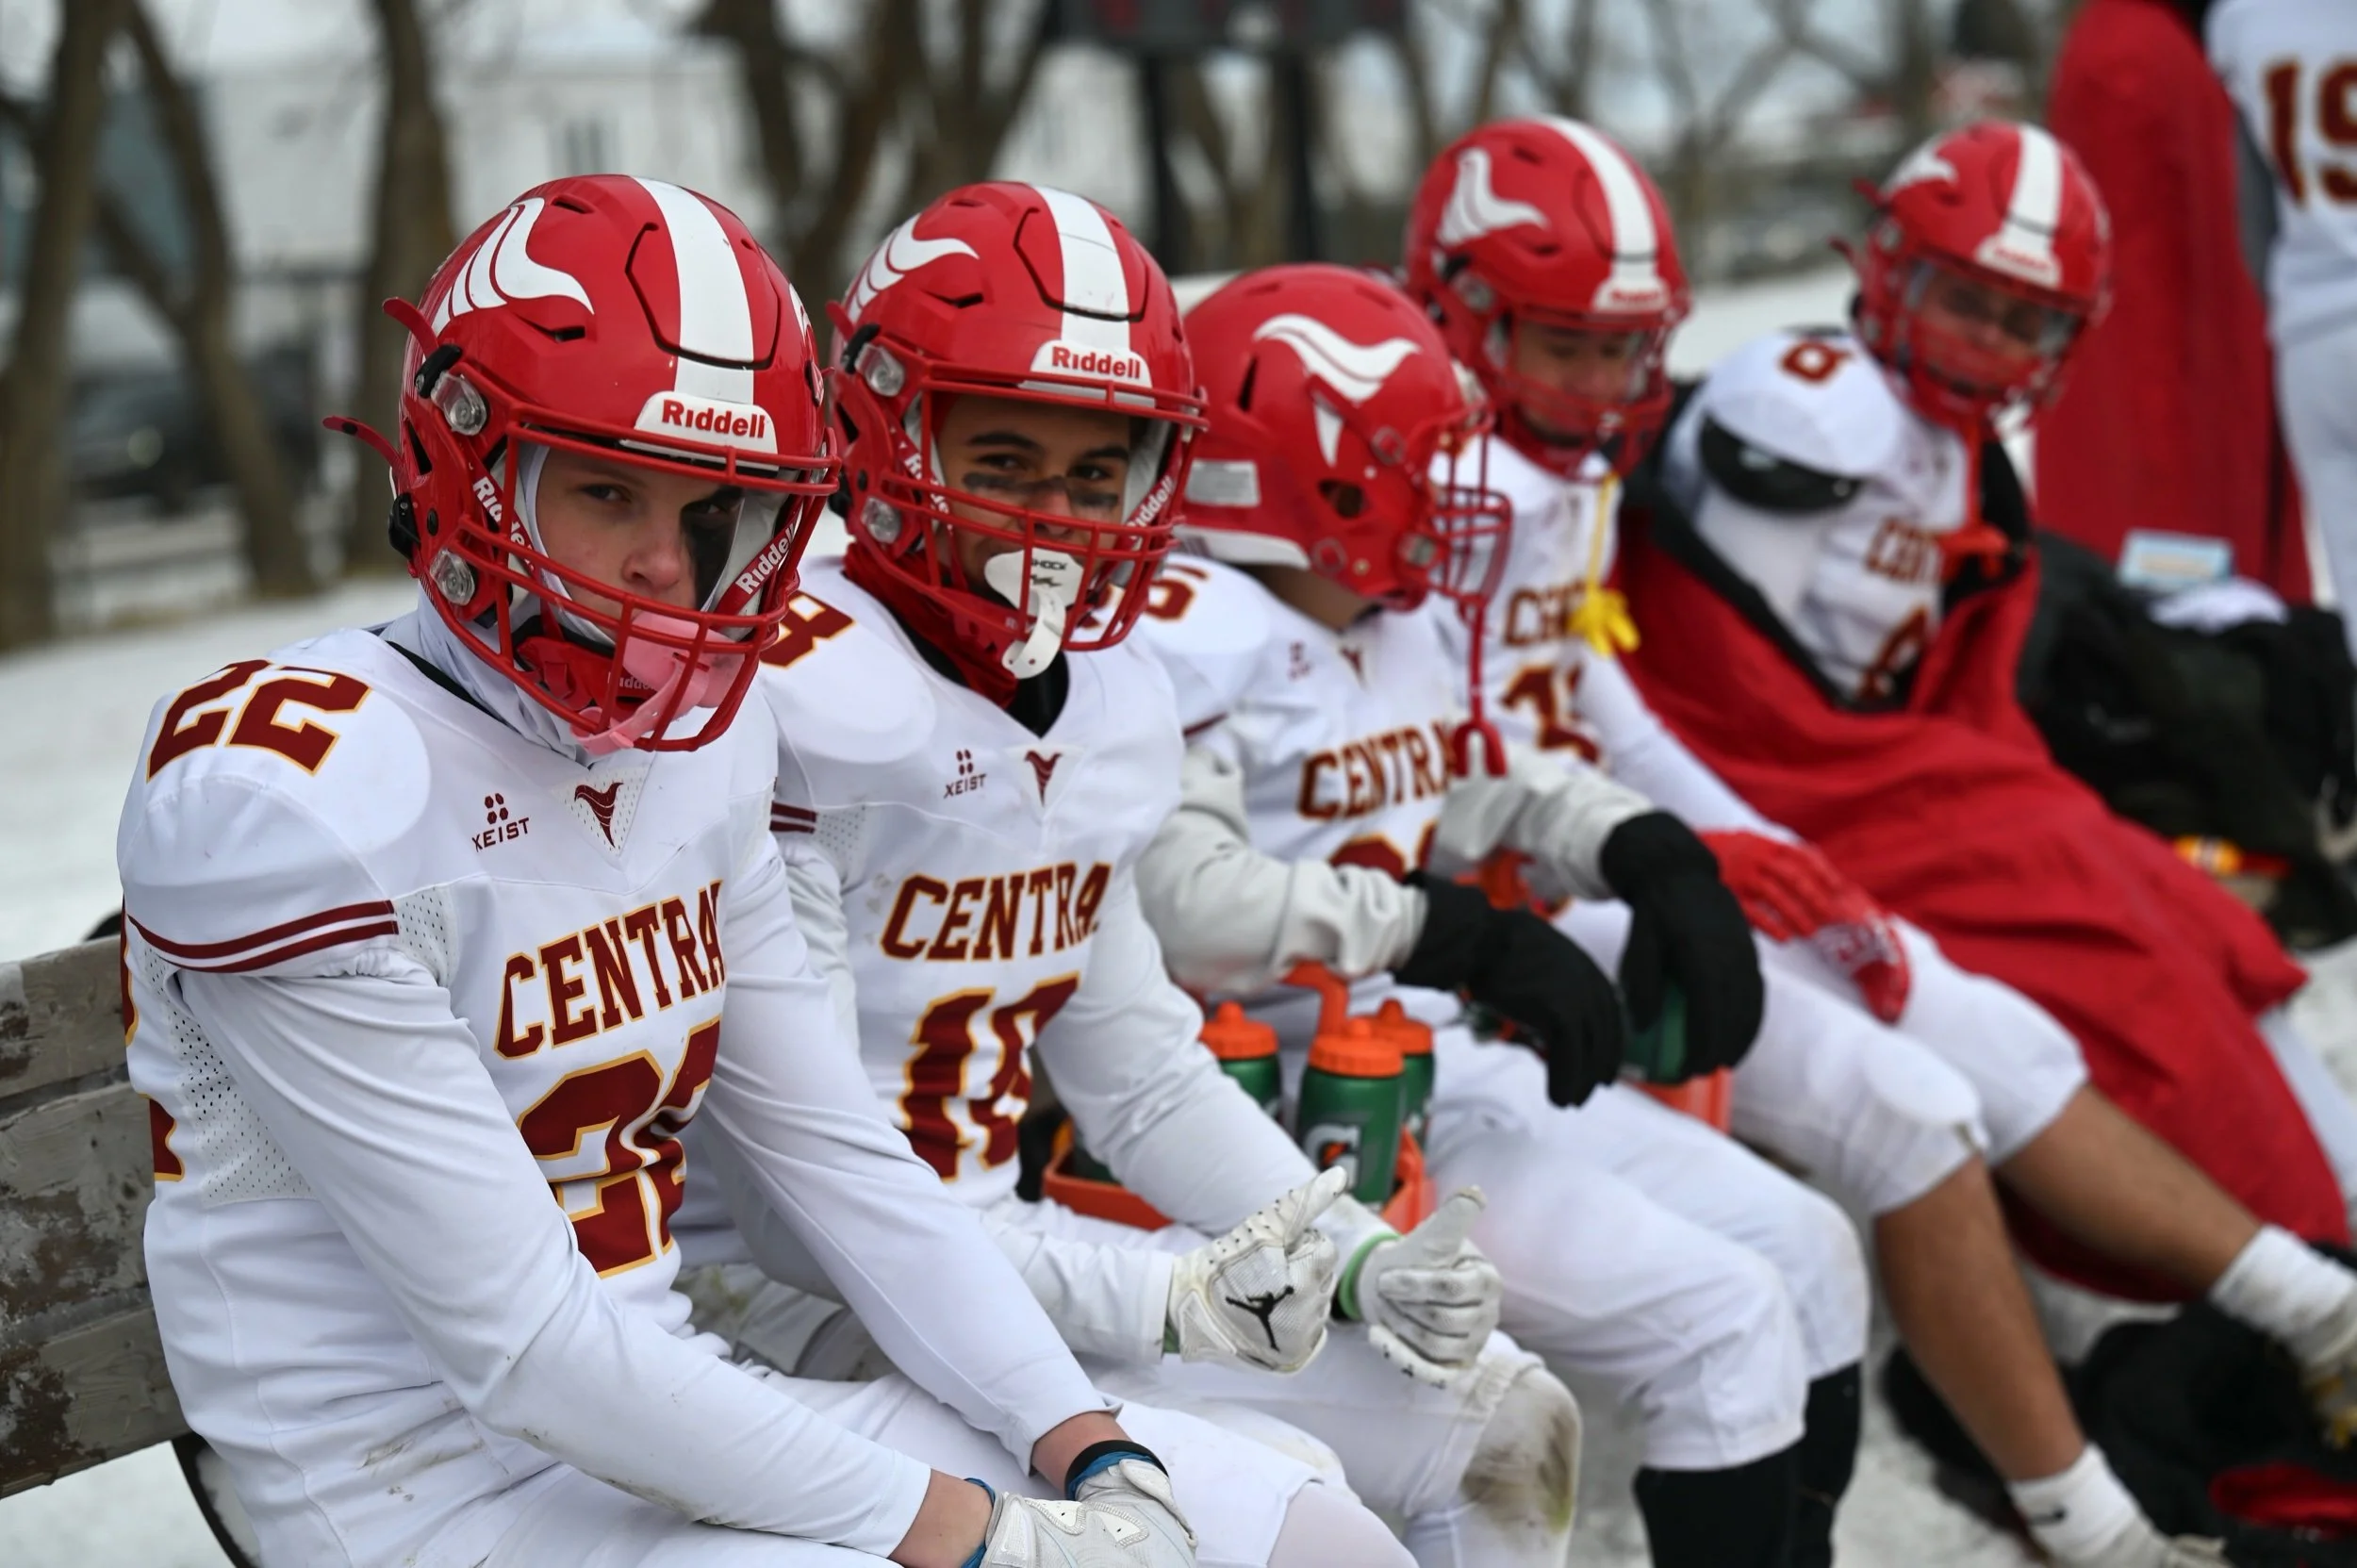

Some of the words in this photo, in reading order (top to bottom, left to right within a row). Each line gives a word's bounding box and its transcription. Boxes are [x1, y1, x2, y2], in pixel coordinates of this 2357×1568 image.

[1052, 346, 1141, 379] Riddell
[662, 399, 766, 438] Riddell
[146, 658, 371, 784] 22
[944, 773, 987, 800] XEIST
[471, 817, 529, 852] XEIST
[880, 860, 1113, 962] CENTRA
[494, 879, 725, 1060] CENTRA
